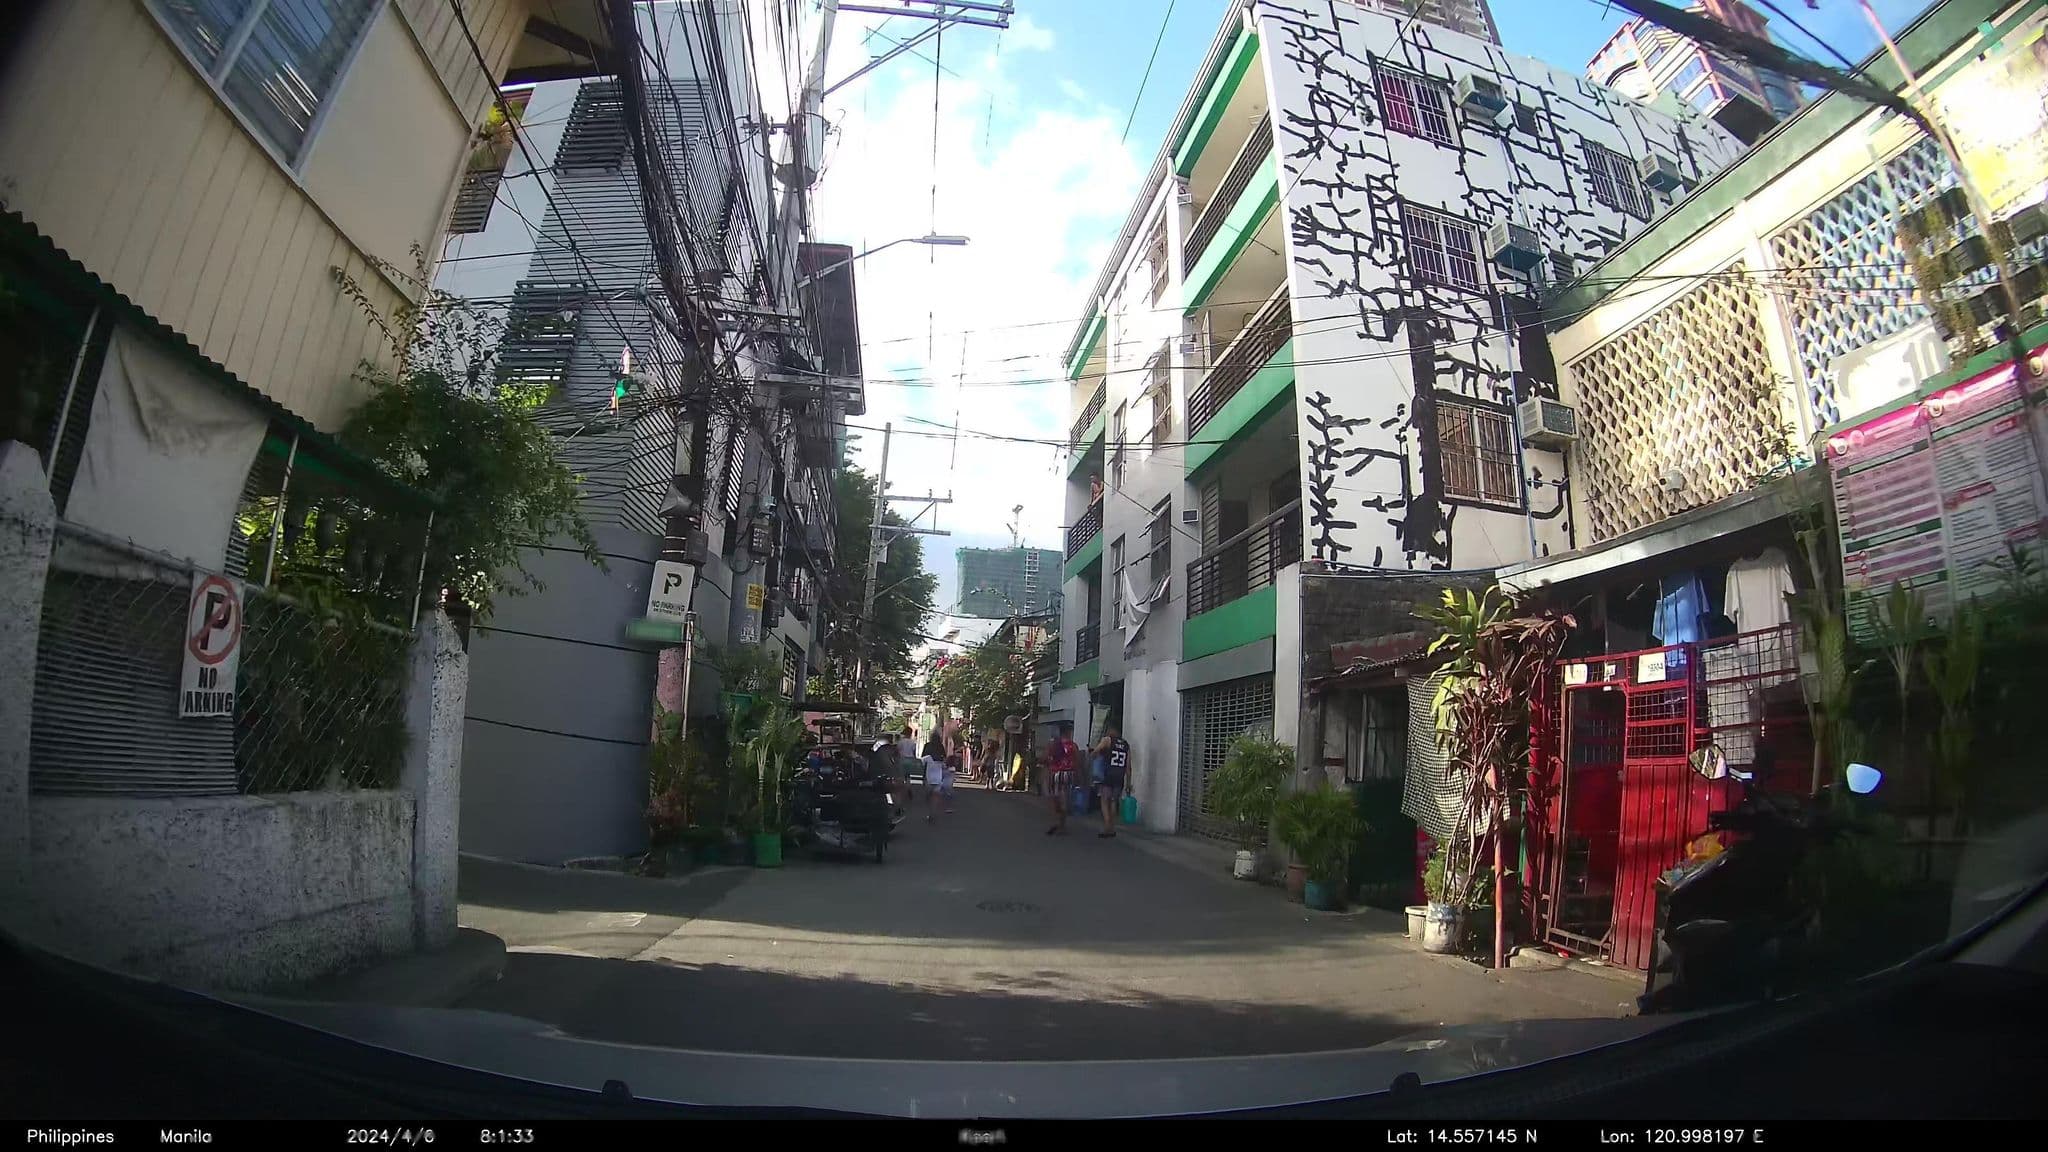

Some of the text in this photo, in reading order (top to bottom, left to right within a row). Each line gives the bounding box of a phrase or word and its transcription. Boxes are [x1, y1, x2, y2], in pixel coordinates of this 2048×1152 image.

[664, 573, 682, 594] P
[660, 602, 685, 611] PARKNG
[200, 591, 231, 650] P
[198, 667, 218, 689] NO
[183, 691, 233, 712] ARKING
[1111, 751, 1126, 766] 23
